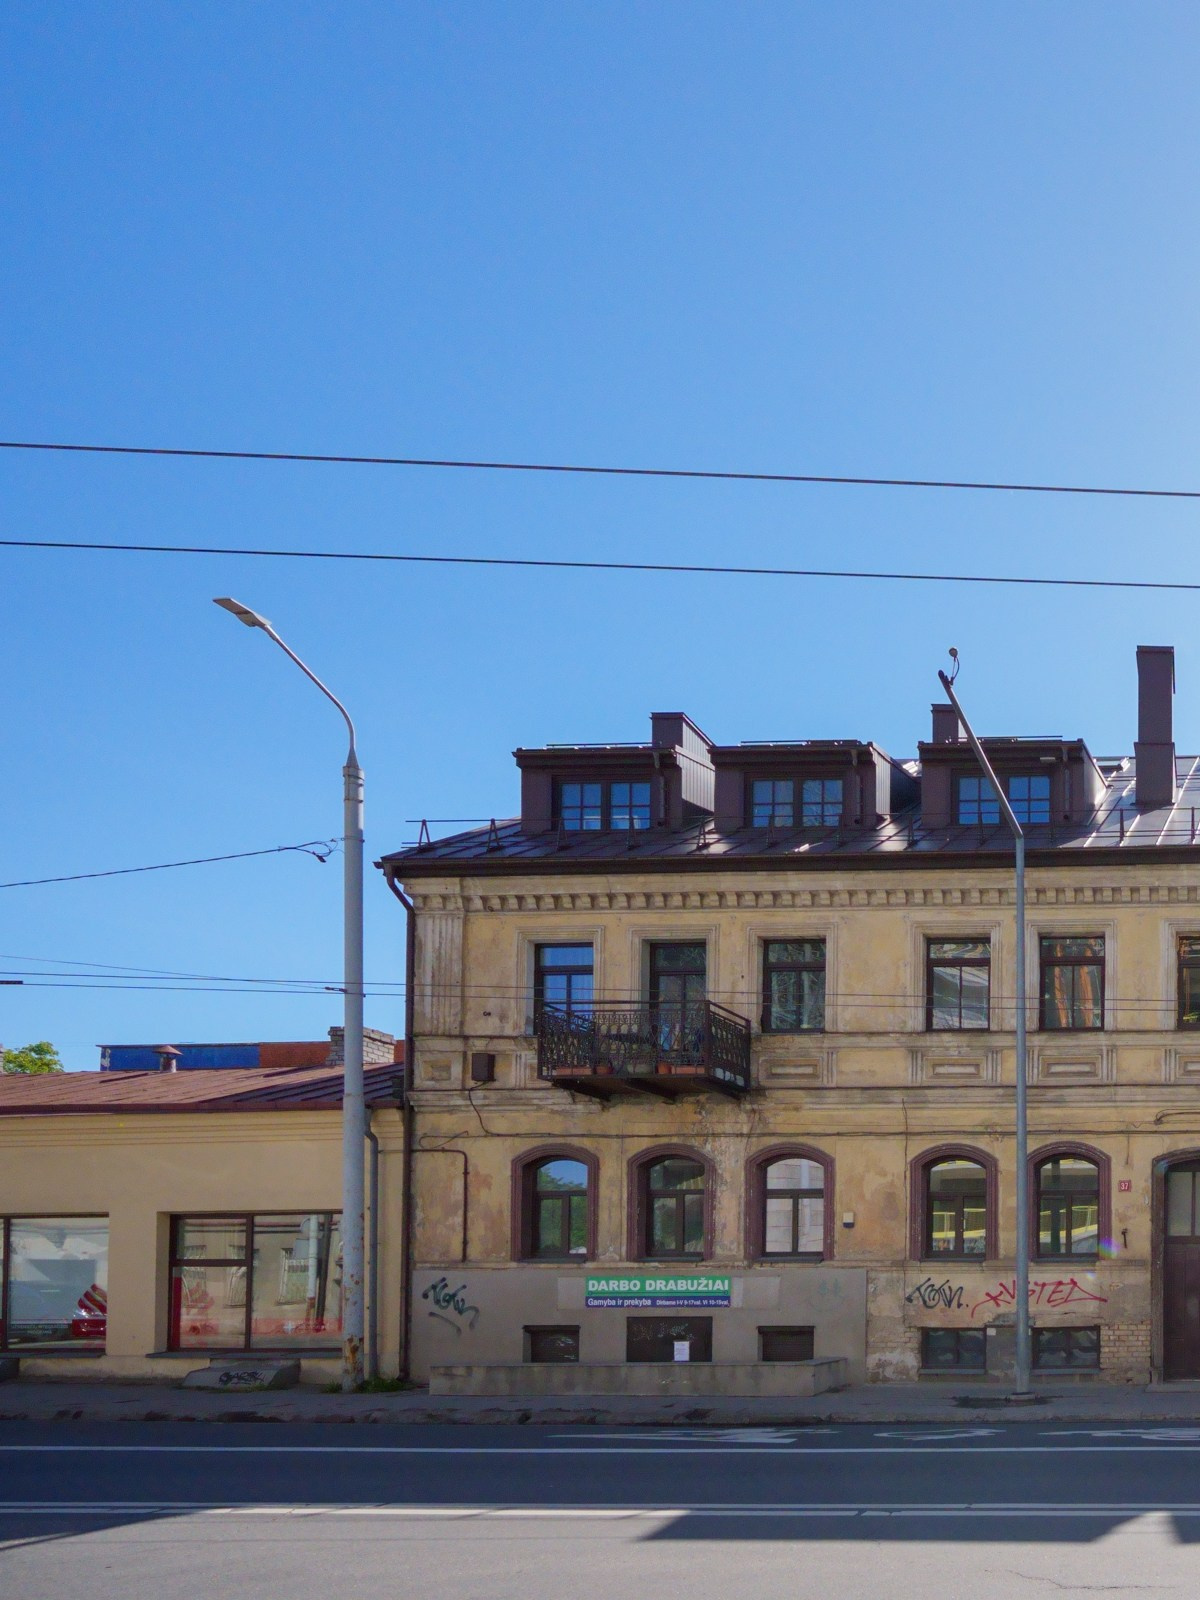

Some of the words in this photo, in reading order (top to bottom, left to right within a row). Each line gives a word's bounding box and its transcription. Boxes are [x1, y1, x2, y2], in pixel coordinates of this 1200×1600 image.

[1120, 1182, 1129, 1190] 37
[588, 1279, 641, 1291] DARBO
[645, 1277, 729, 1291] DRABUŽIAI
[587, 1298, 616, 1307] Gamyba
[617, 1298, 623, 1306] ir
[624, 1298, 652, 1307] prekyba
